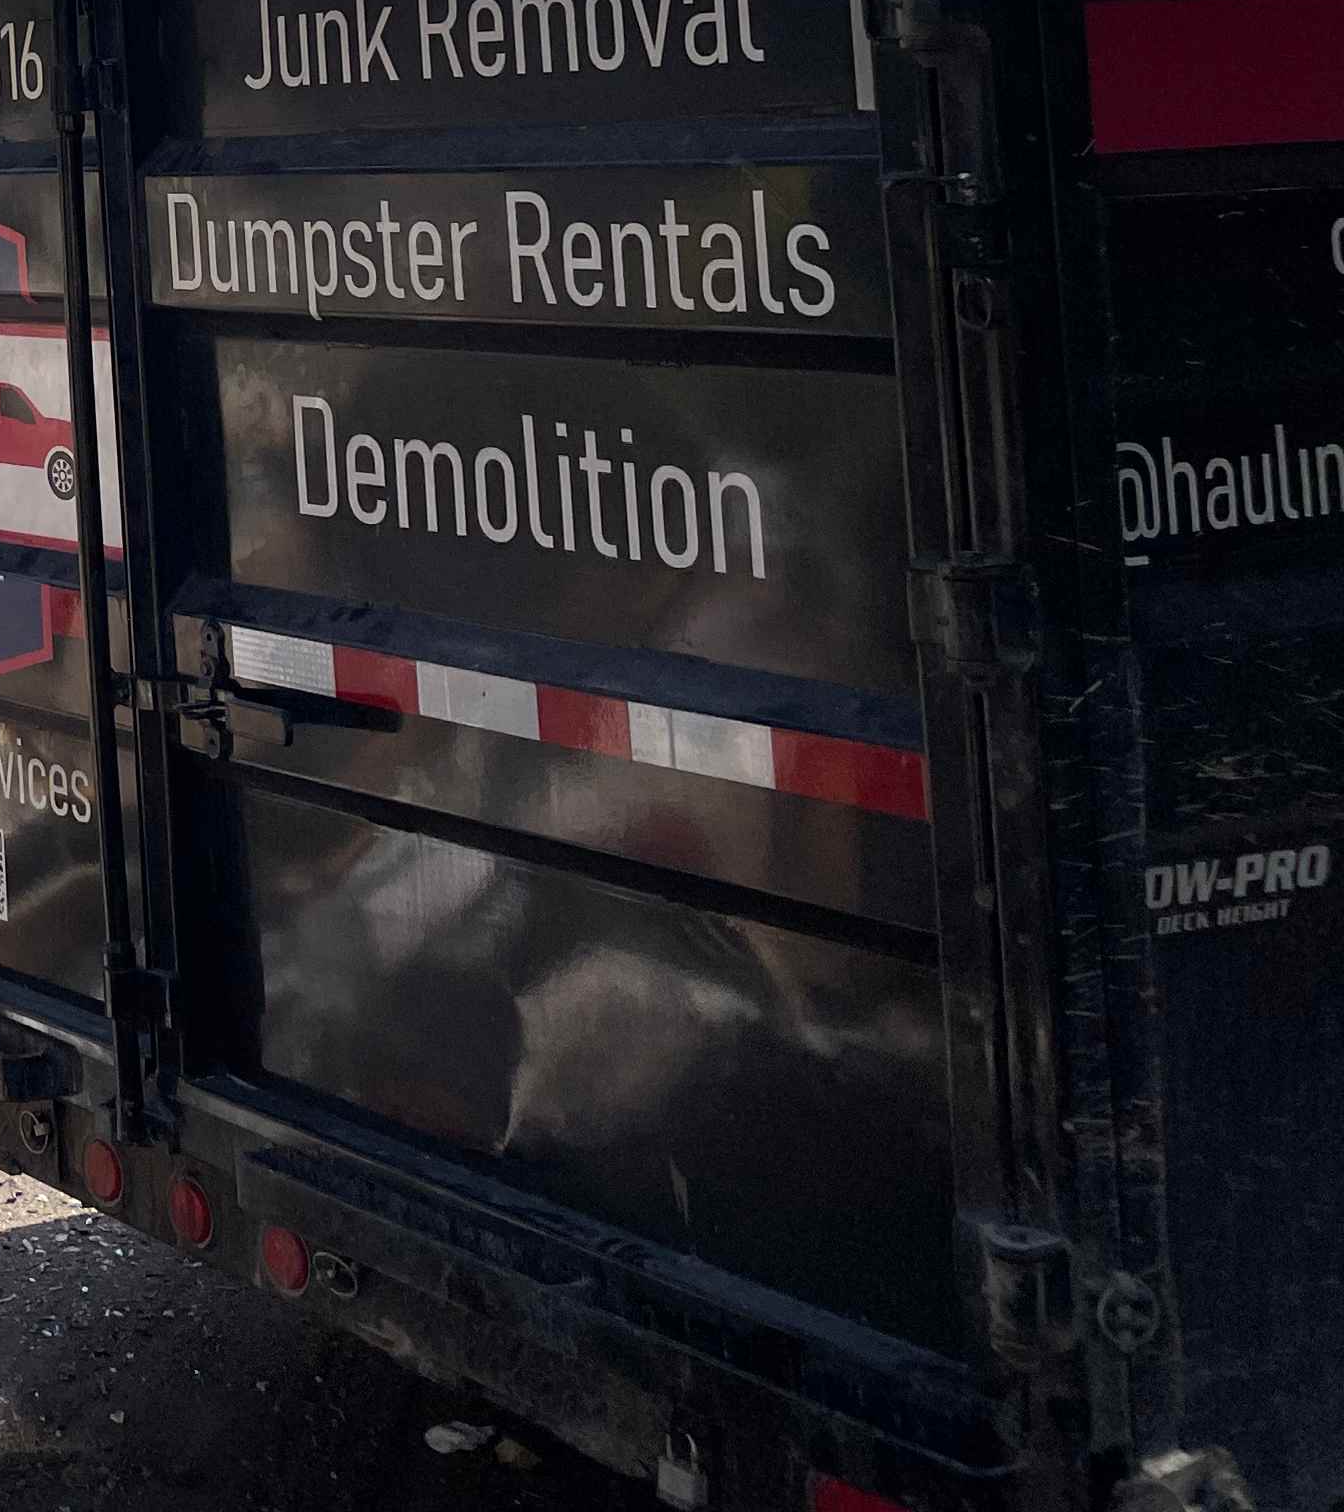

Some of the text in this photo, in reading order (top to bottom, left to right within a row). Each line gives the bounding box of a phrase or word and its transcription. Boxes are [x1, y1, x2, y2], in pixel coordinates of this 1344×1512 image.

[167, 190, 837, 321] Dumpster Rentals
[291, 394, 767, 580] Demolition
